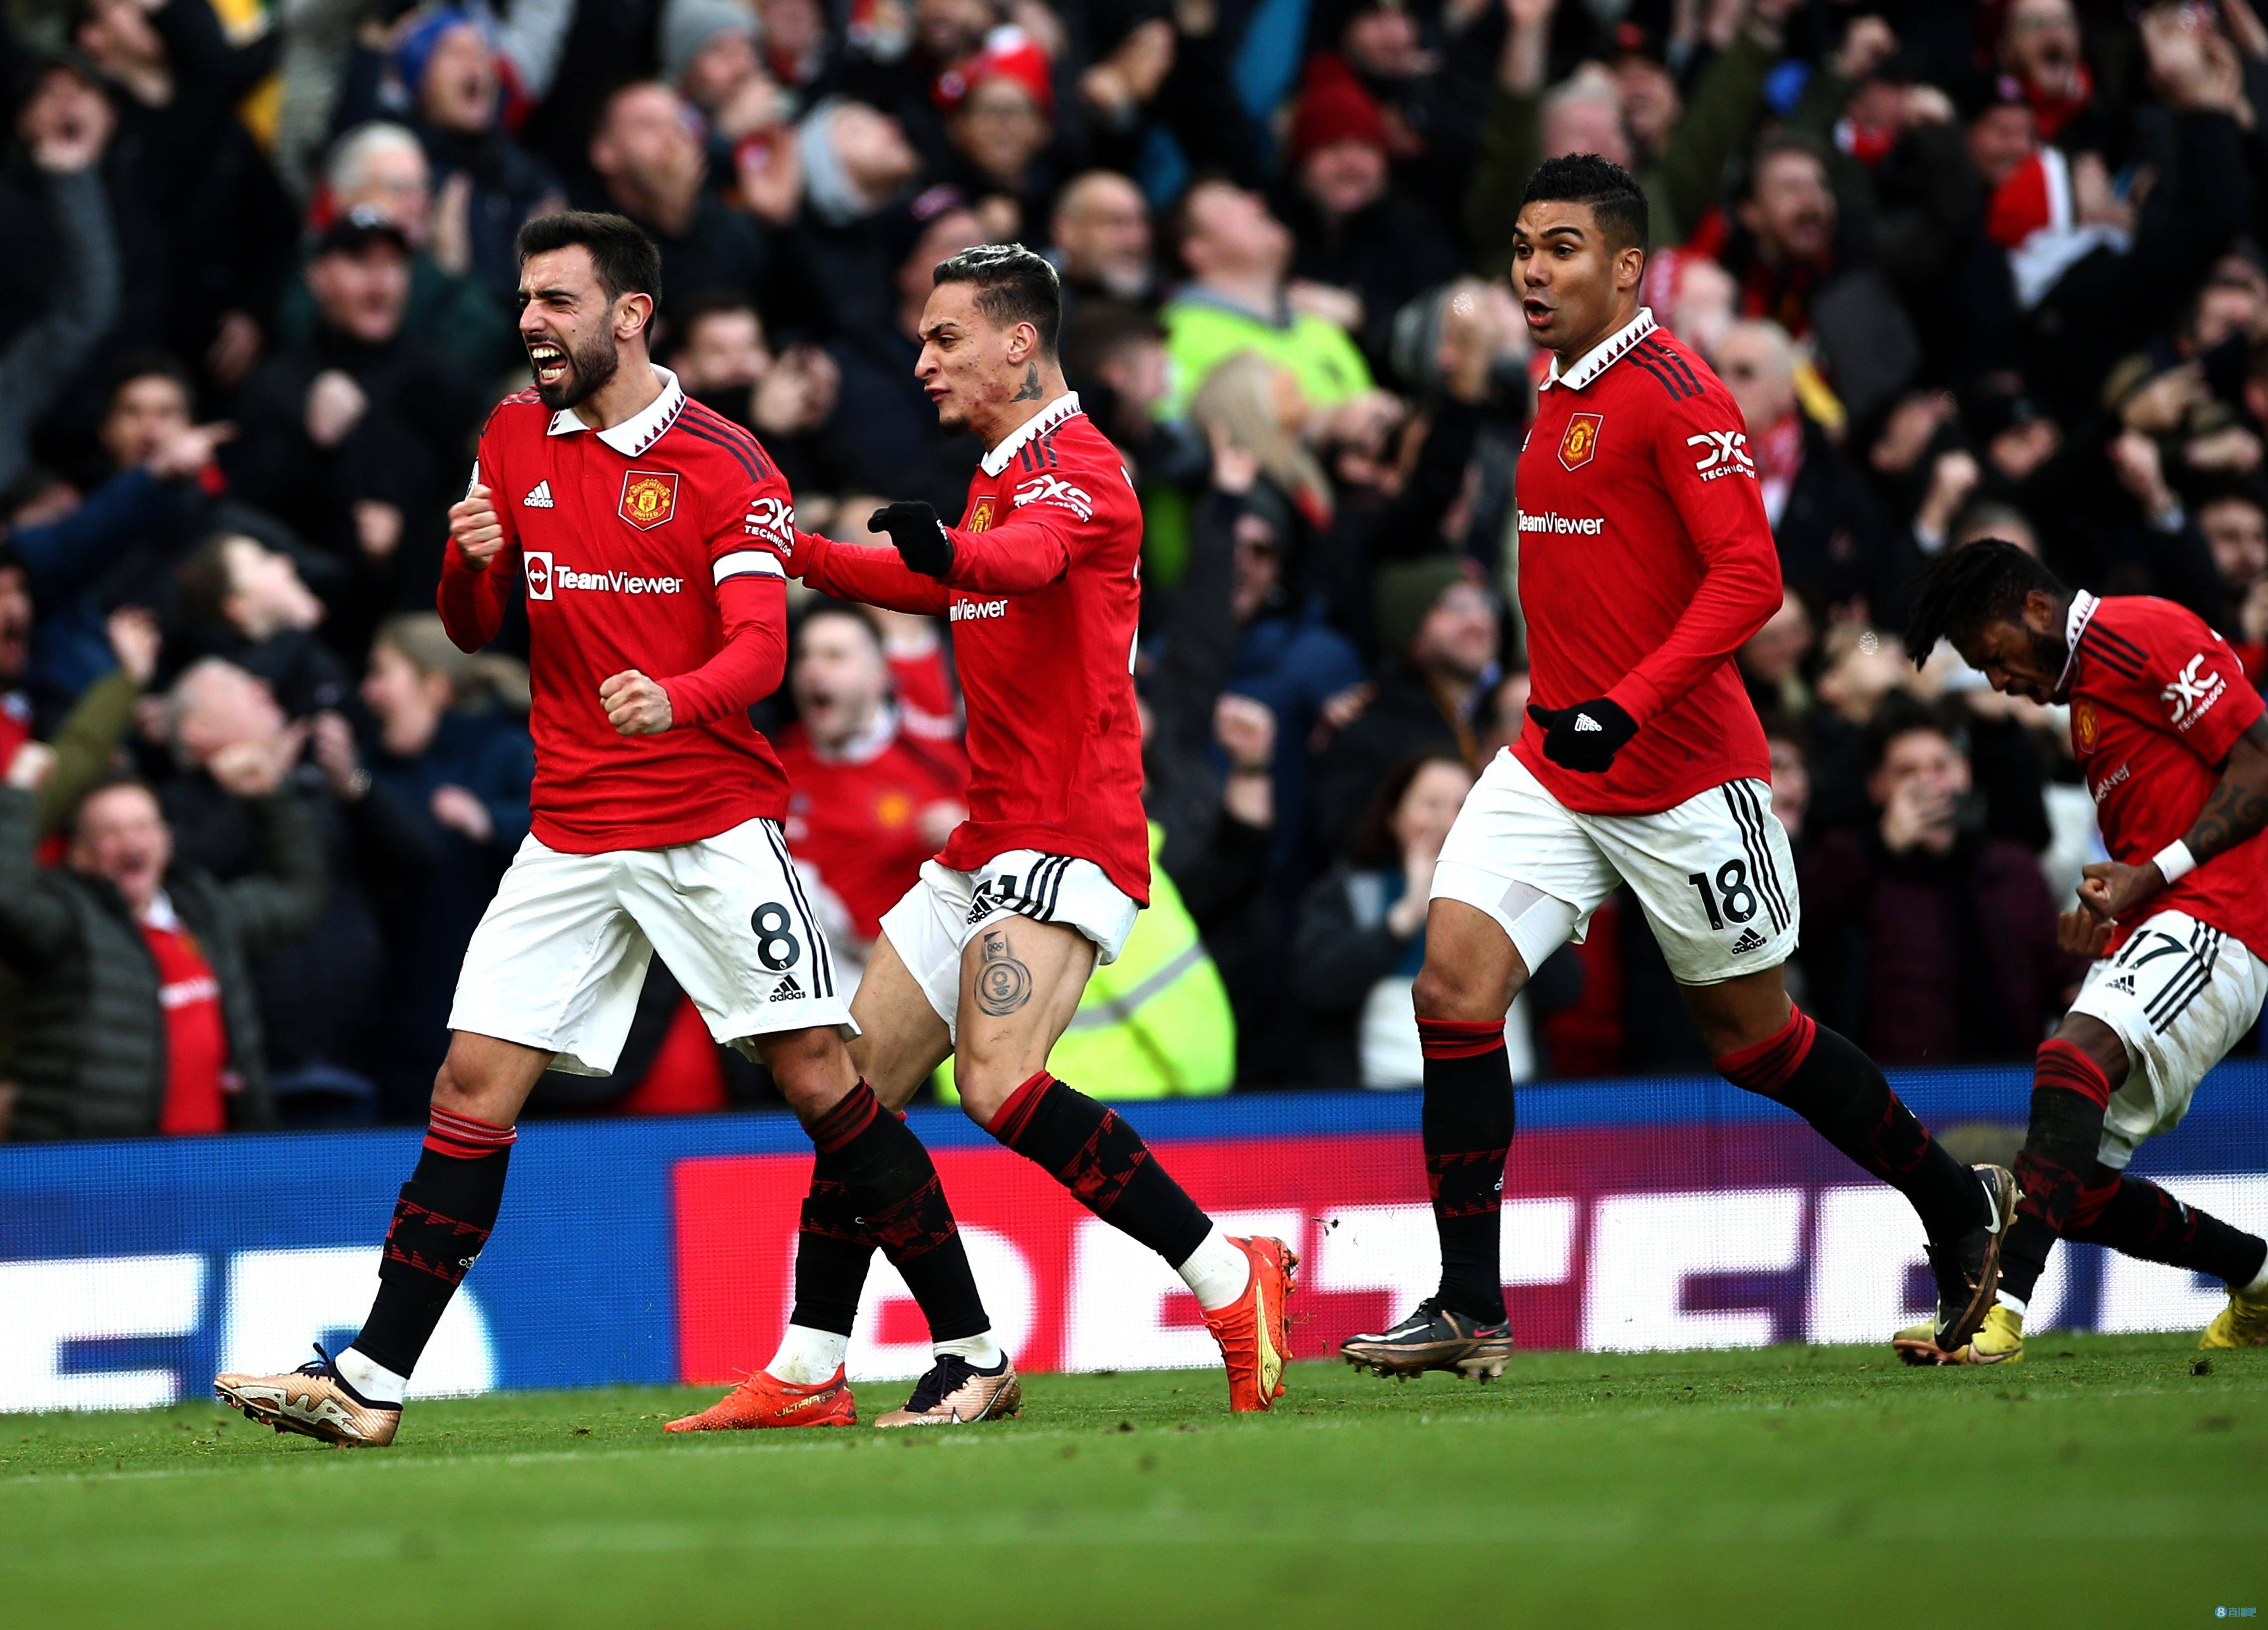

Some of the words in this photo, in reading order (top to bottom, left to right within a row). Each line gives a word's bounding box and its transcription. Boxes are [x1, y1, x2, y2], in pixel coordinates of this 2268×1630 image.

[523, 496, 553, 507] adidas
[1518, 509, 1604, 535] TeamViewer
[745, 525, 792, 557] TECHNOLOG
[554, 566, 683, 594] TeamViewer
[950, 598, 1008, 622] mViewer
[1689, 859, 1757, 931] 18
[751, 902, 800, 971] 8
[1732, 937, 1767, 955] adidas
[2115, 930, 2189, 970] 17
[769, 989, 806, 1002] adidas
